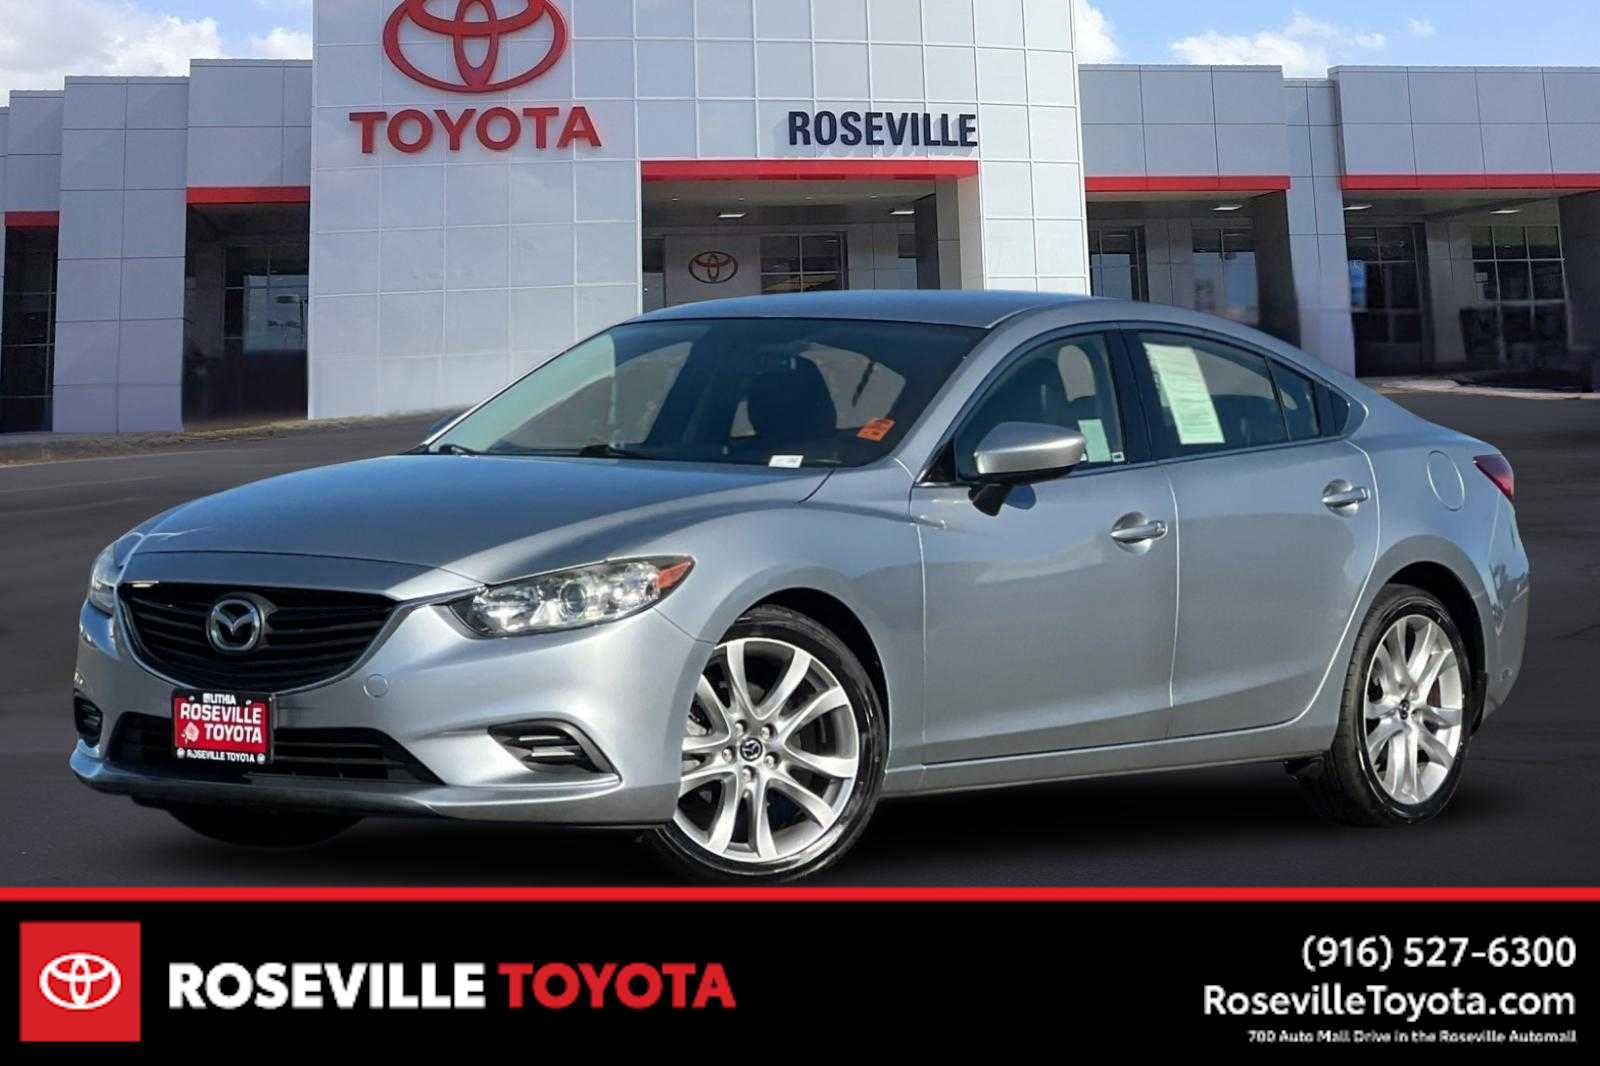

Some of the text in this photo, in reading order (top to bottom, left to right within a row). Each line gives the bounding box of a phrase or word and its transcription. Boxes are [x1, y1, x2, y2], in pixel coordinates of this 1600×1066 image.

[349, 106, 602, 153] TOYOTA
[788, 111, 978, 147] ROSEVILLE
[180, 703, 262, 724] ROSEVILLE
[204, 723, 263, 744] TOYOTA
[186, 749, 255, 763] ROSEVILLE TOYOTA
